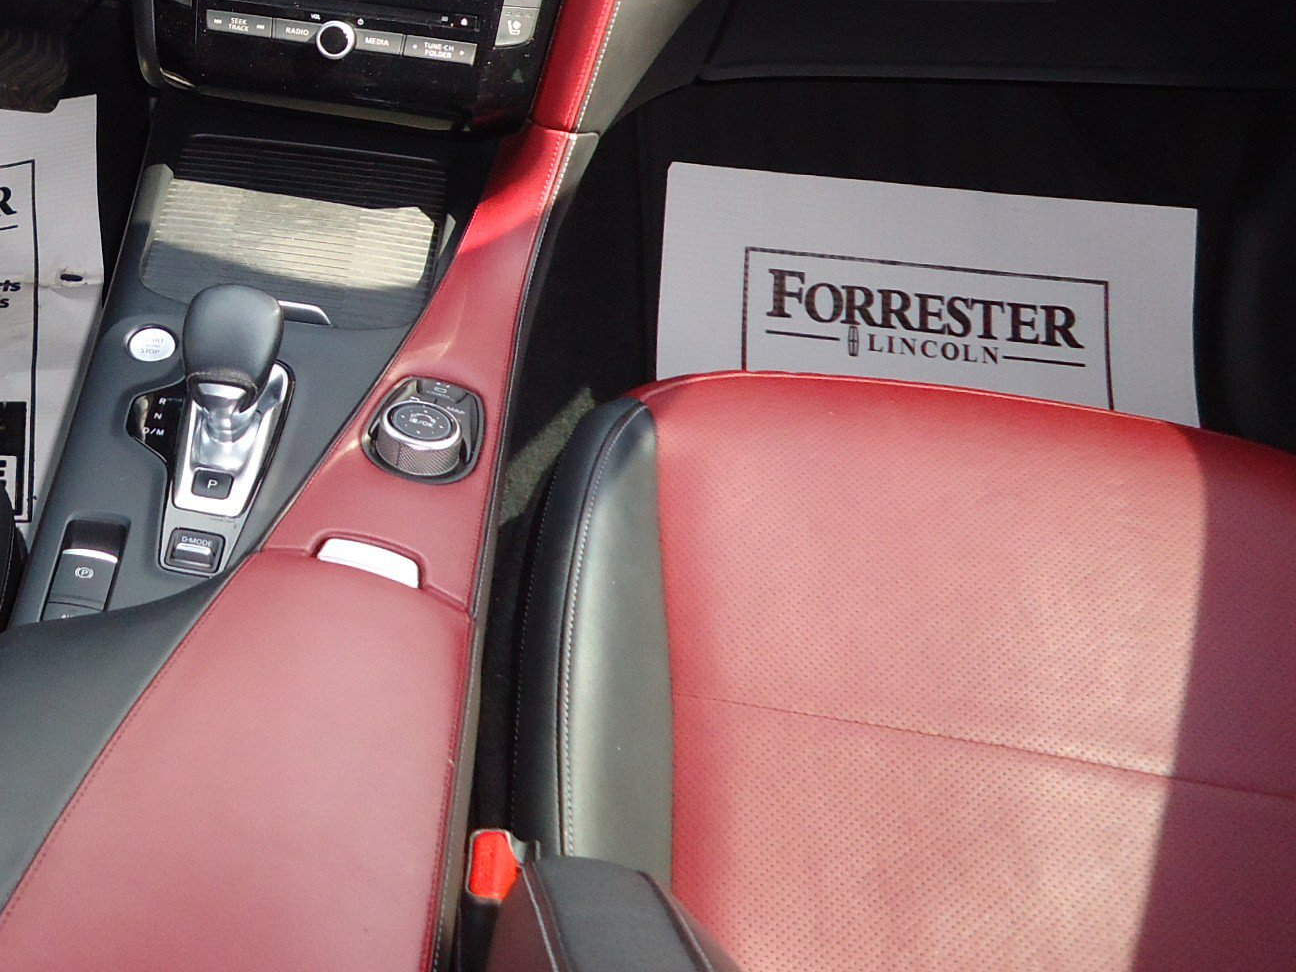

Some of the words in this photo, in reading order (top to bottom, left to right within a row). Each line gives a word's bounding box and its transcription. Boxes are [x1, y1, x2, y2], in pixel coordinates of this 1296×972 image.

[230, 17, 247, 26] SEEK
[310, 13, 321, 21] VOL
[228, 23, 250, 33] TRACK
[285, 26, 310, 37] RADIO
[364, 37, 390, 47] MEDIA
[424, 49, 453, 59] FOLDER
[765, 268, 1085, 349] FORRESTER
[868, 333, 999, 364] LINCOLN
[158, 397, 167, 406] R
[153, 412, 163, 420] N
[143, 427, 165, 436] D/M
[206, 479, 218, 489] P
